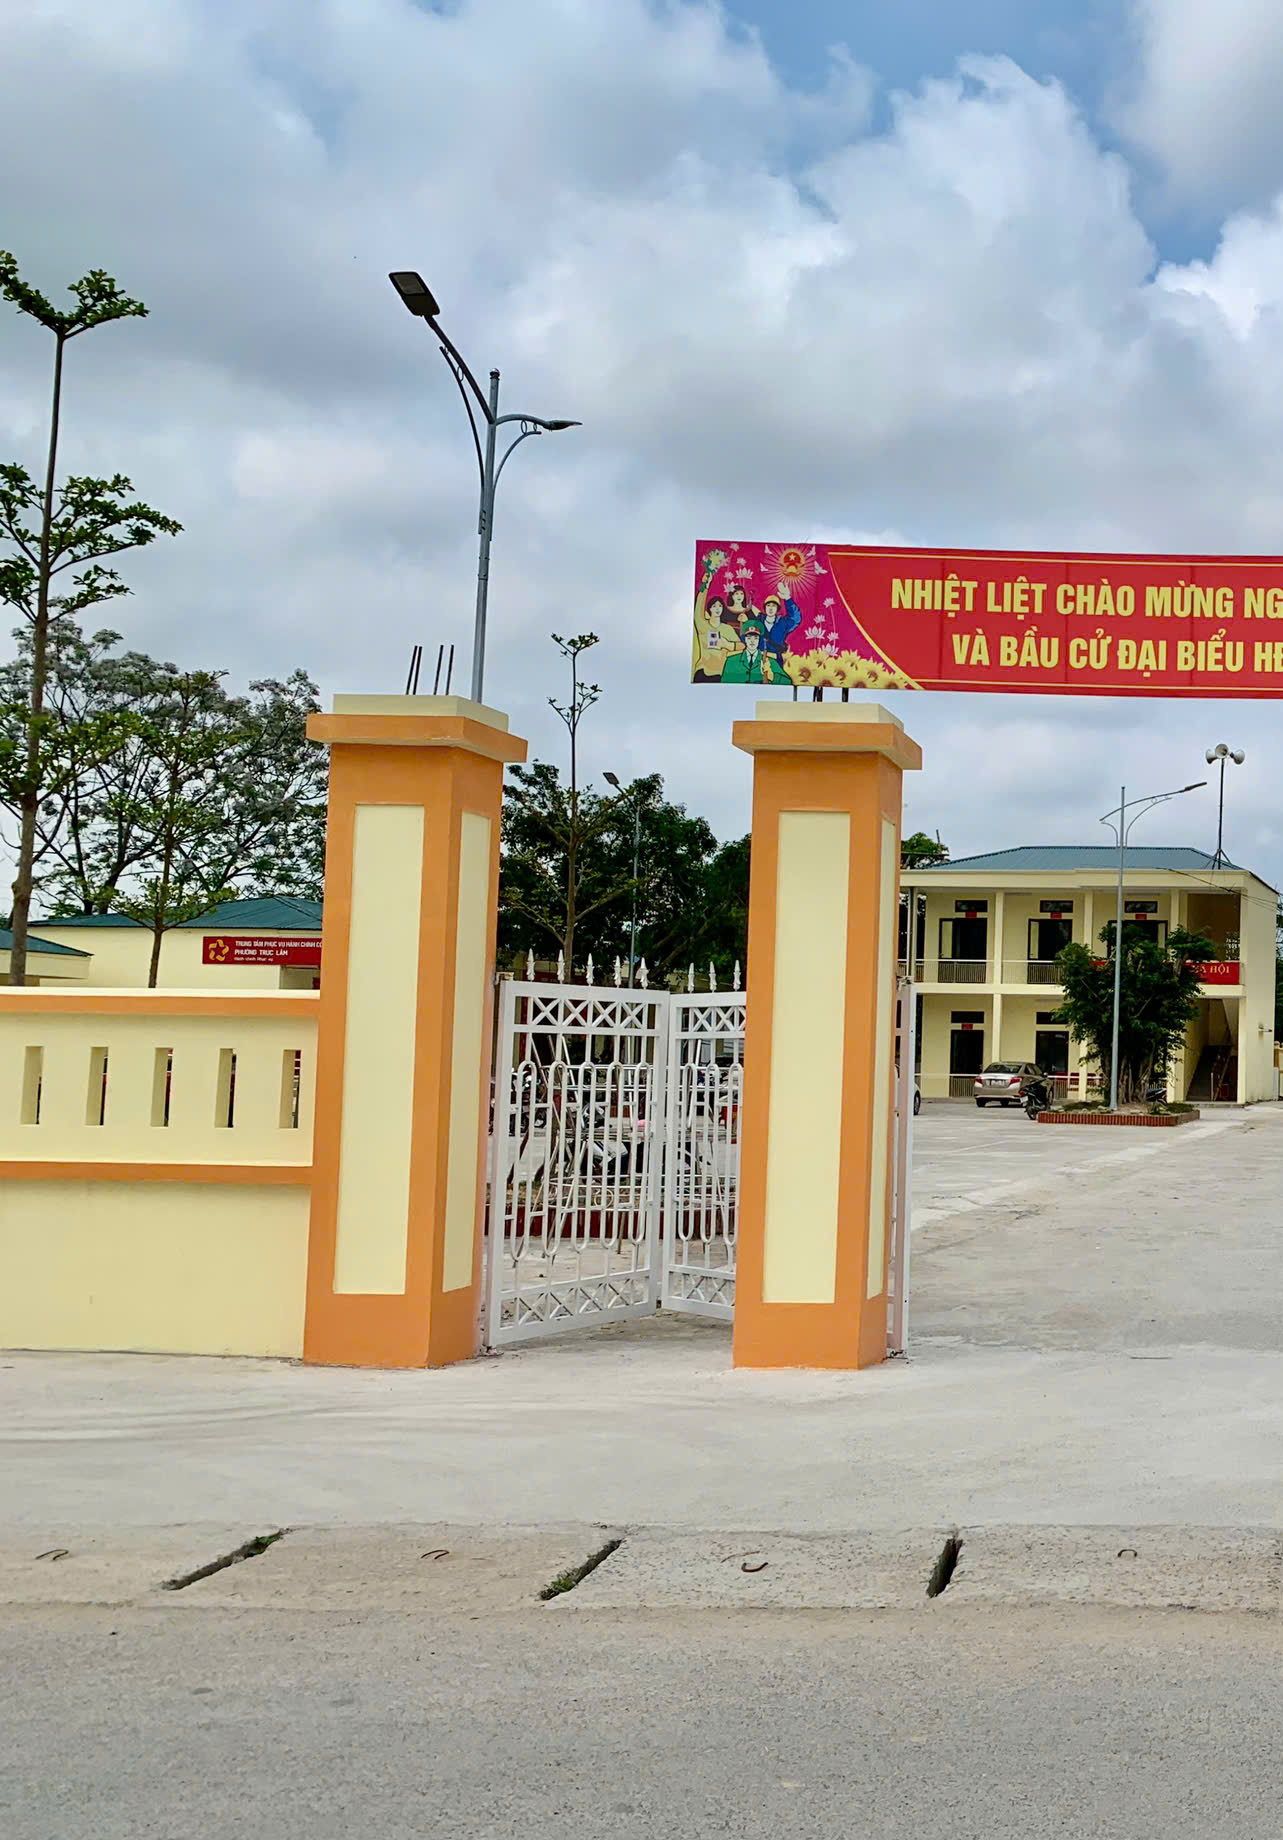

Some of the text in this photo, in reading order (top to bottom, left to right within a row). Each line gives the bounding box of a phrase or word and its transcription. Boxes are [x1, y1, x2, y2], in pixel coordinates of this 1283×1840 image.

[891, 573, 978, 618] NHIỆT
[986, 575, 1048, 621] LIỆT
[1056, 578, 1135, 617] CHÀO
[1144, 580, 1234, 619] MỪNG
[951, 630, 990, 666] VÀ
[999, 627, 1059, 669] BẦU
[1068, 629, 1112, 670] CỬ
[1116, 638, 1167, 678] ĐẠI
[1176, 628, 1244, 673] BIỂU
[1210, 963, 1230, 975] HỘI
